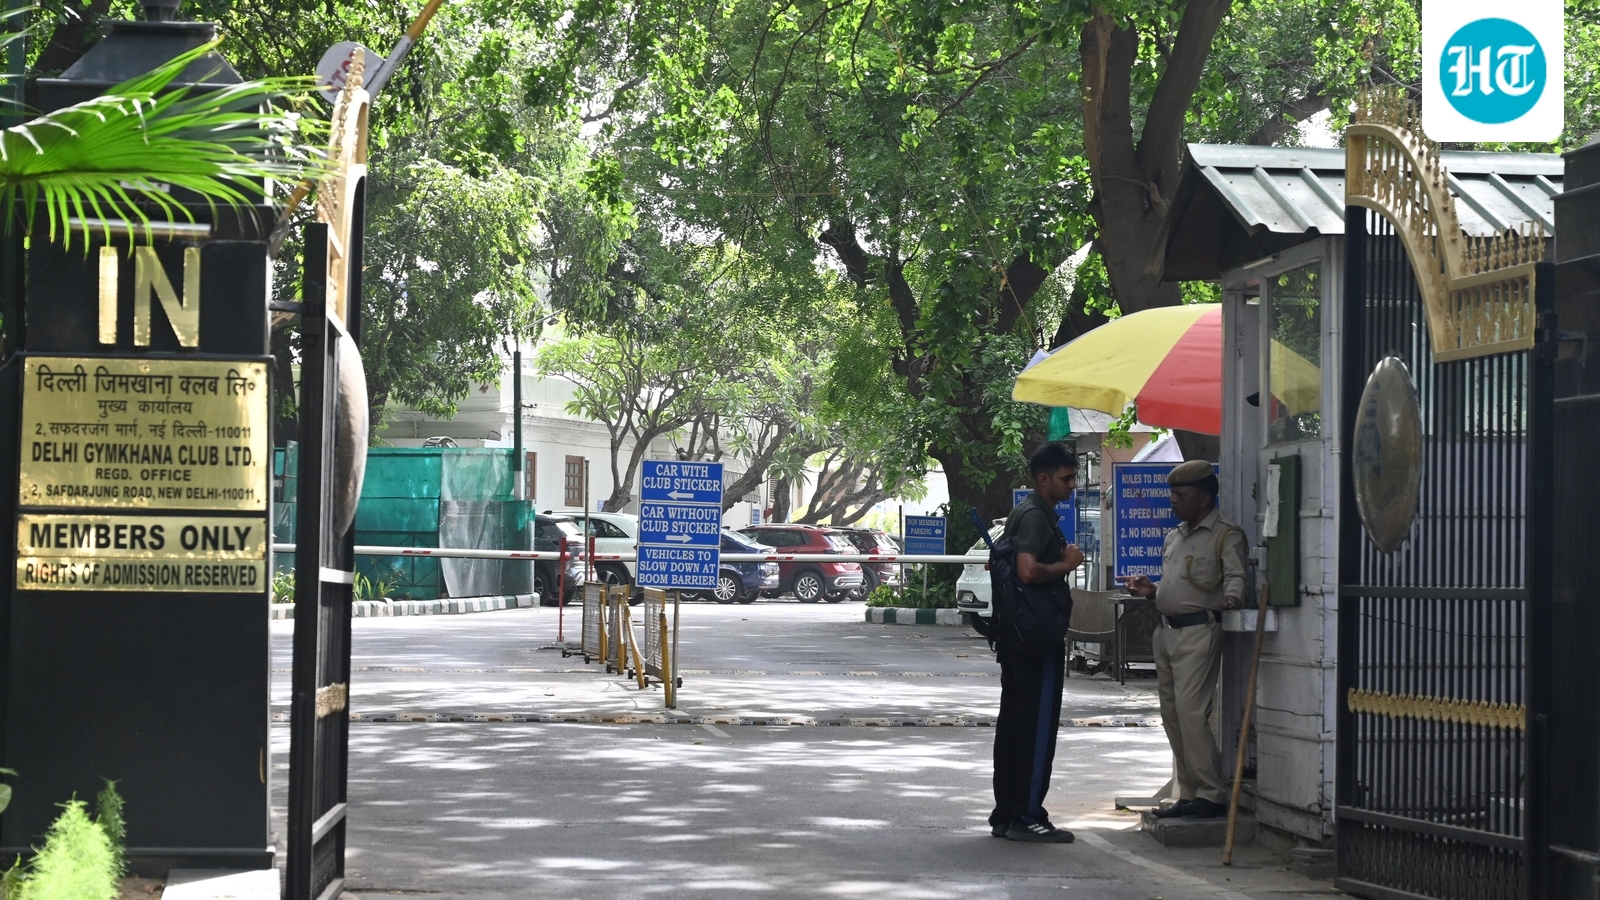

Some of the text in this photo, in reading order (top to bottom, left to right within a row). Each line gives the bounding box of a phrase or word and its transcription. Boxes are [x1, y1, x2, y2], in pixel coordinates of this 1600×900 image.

[98, 246, 201, 347] IN
[36, 364, 87, 392] दिल्ली
[94, 366, 173, 395] जिमखाना
[97, 396, 193, 418] मुख्य कार्यालय
[148, 419, 166, 439] नई
[32, 441, 78, 463] DELHI
[84, 443, 173, 465] GYMKHANA
[178, 445, 219, 466] CLUB
[95, 467, 191, 482] REGD. OFFICE
[656, 464, 709, 478] CAR WITH
[643, 476, 720, 491] CLUB STICKER
[1143, 474, 1152, 484] TO
[1153, 474, 1169, 484] DRIV
[46, 484, 119, 498] SAFDARJUNG
[123, 486, 156, 500] ROAD,
[157, 487, 182, 499] NEW
[186, 487, 254, 500] DELHI-110011
[1141, 487, 1172, 498] GYMKHAN
[642, 506, 719, 520] CAR WITHOUT
[1121, 507, 1172, 519] 1. SPEED LIMIT
[641, 520, 718, 534] CLUB STICKER
[907, 518, 918, 526] NON
[30, 523, 252, 551] MEMBERS ONLY
[910, 527, 932, 535] PARKING
[1121, 527, 1127, 538] 2.
[1128, 527, 1139, 538] NO
[1140, 527, 1161, 538] HORN
[645, 549, 711, 561] VEHICLES TO
[1121, 546, 1162, 557] 3. ONE-WAY
[640, 561, 716, 573] SLOW DOWN AT
[1121, 565, 1126, 576] 4.
[25, 563, 257, 586] RIGHTS OF ADMISSION RESERVED
[639, 573, 716, 585] BOOM BARRIER
